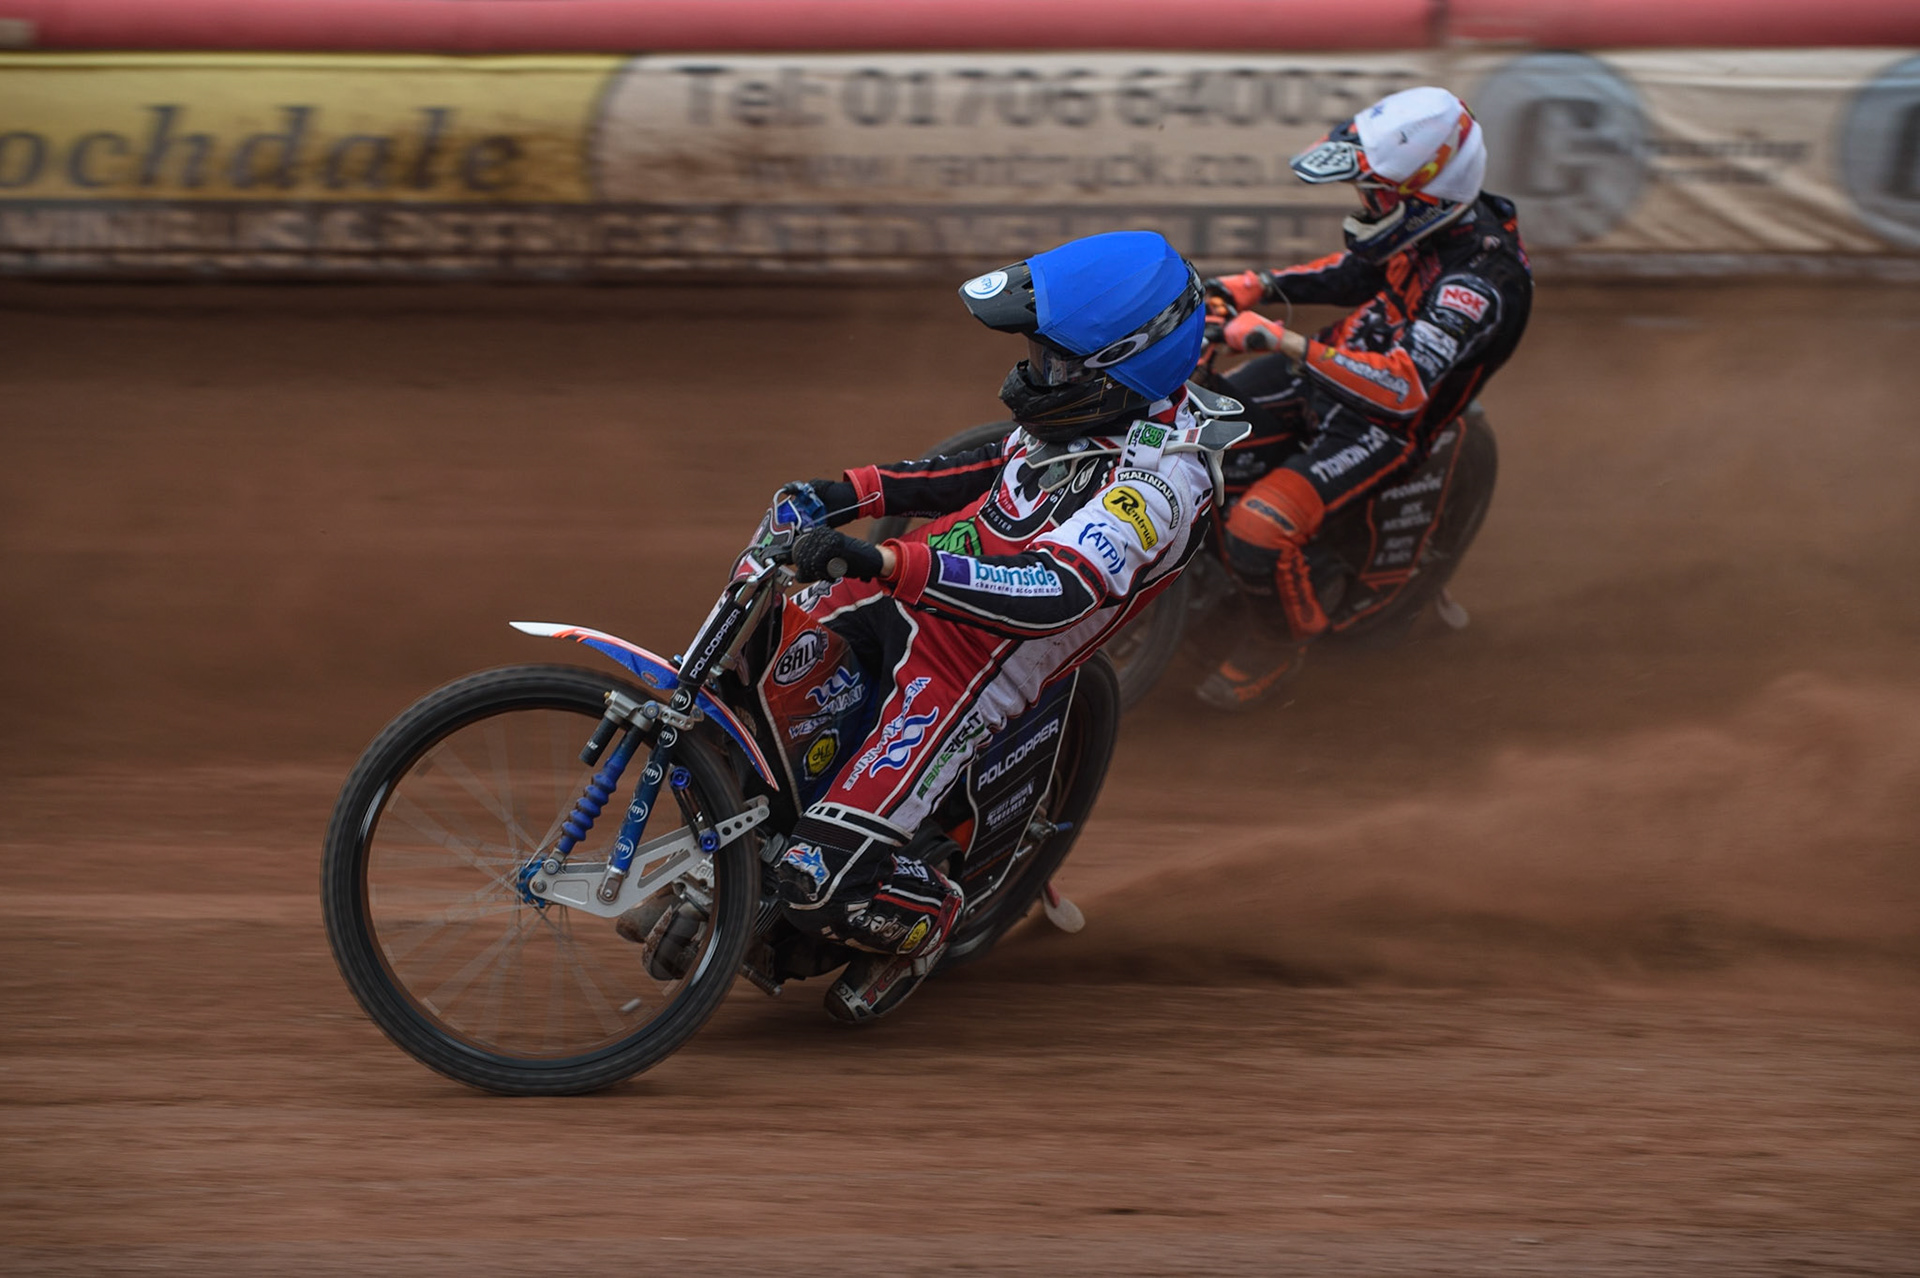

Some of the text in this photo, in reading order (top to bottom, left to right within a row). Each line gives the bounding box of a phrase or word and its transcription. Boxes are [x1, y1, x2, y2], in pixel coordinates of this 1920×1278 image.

[843, 66, 1100, 128] 01706
[1442, 286, 1486, 315] NGK
[1111, 489, 1155, 547] Rentruck
[974, 559, 1059, 587] burnside
[1086, 530, 1121, 576] ATPI
[689, 608, 741, 680] POLCOPPER
[842, 677, 931, 791] WESSEXMARINE
[977, 718, 1059, 791] POLCOPPER
